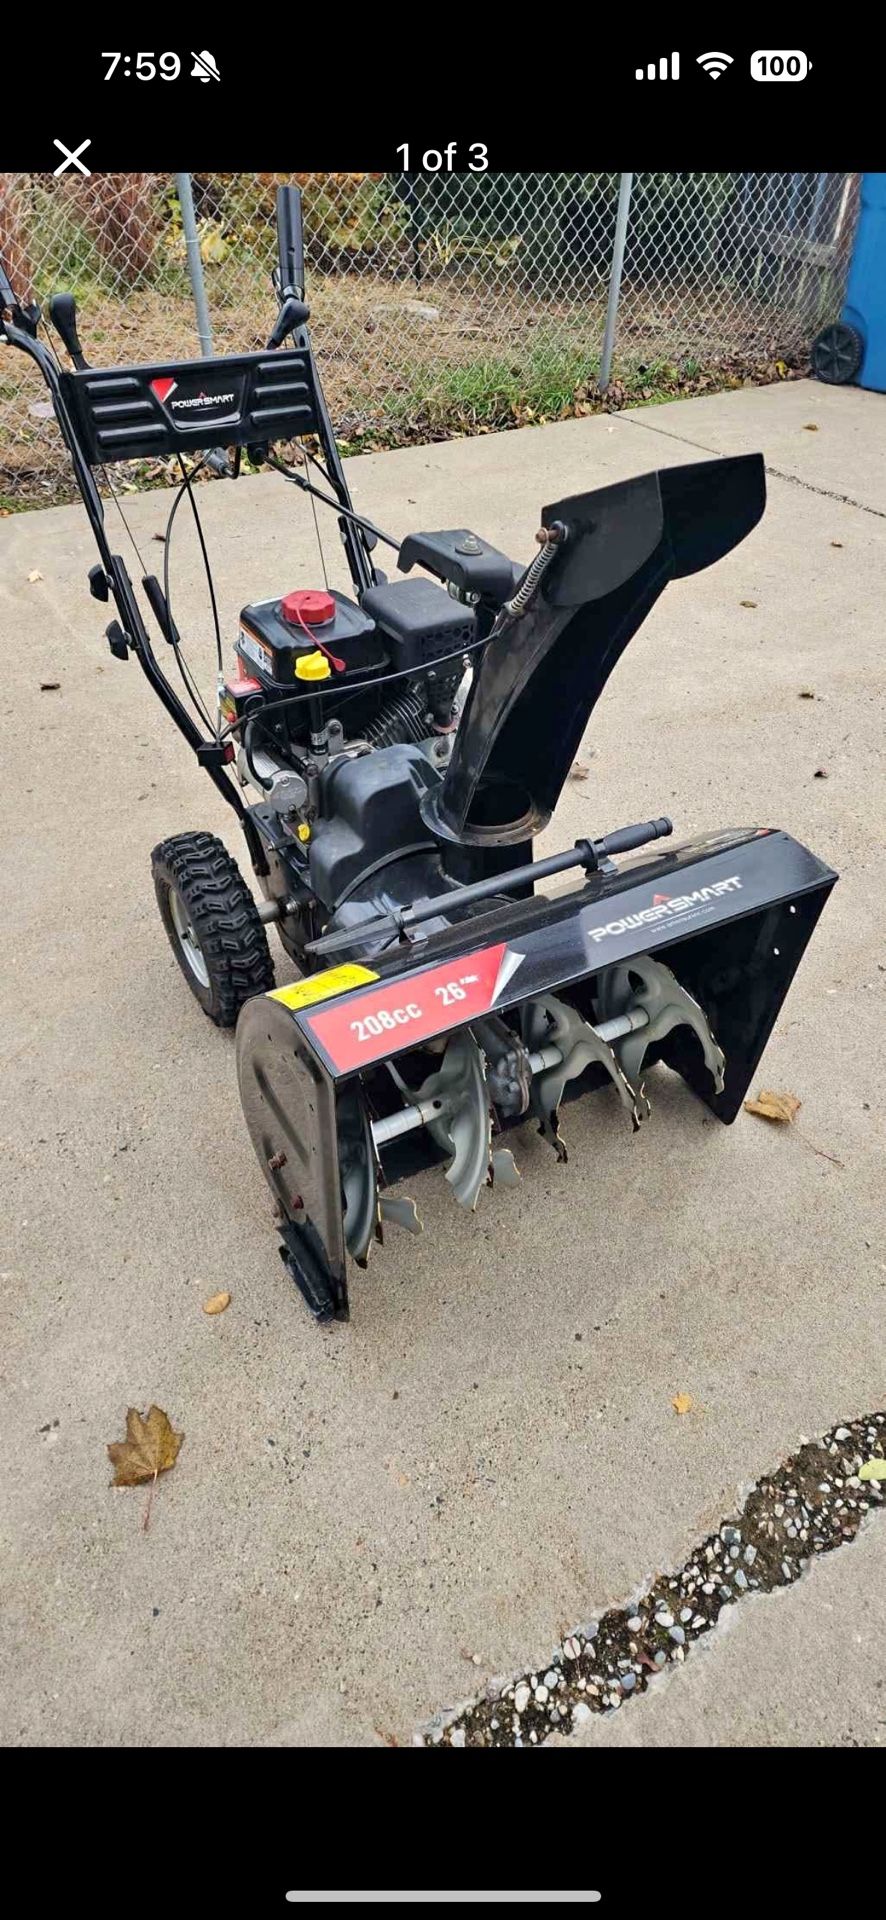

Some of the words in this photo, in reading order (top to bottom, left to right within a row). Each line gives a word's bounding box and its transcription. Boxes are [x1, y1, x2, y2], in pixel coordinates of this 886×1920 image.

[171, 393, 235, 410] POWERSMART
[587, 876, 744, 942] POWERSMART
[350, 1003, 422, 1041] 208cc
[434, 982, 467, 1006] 26
